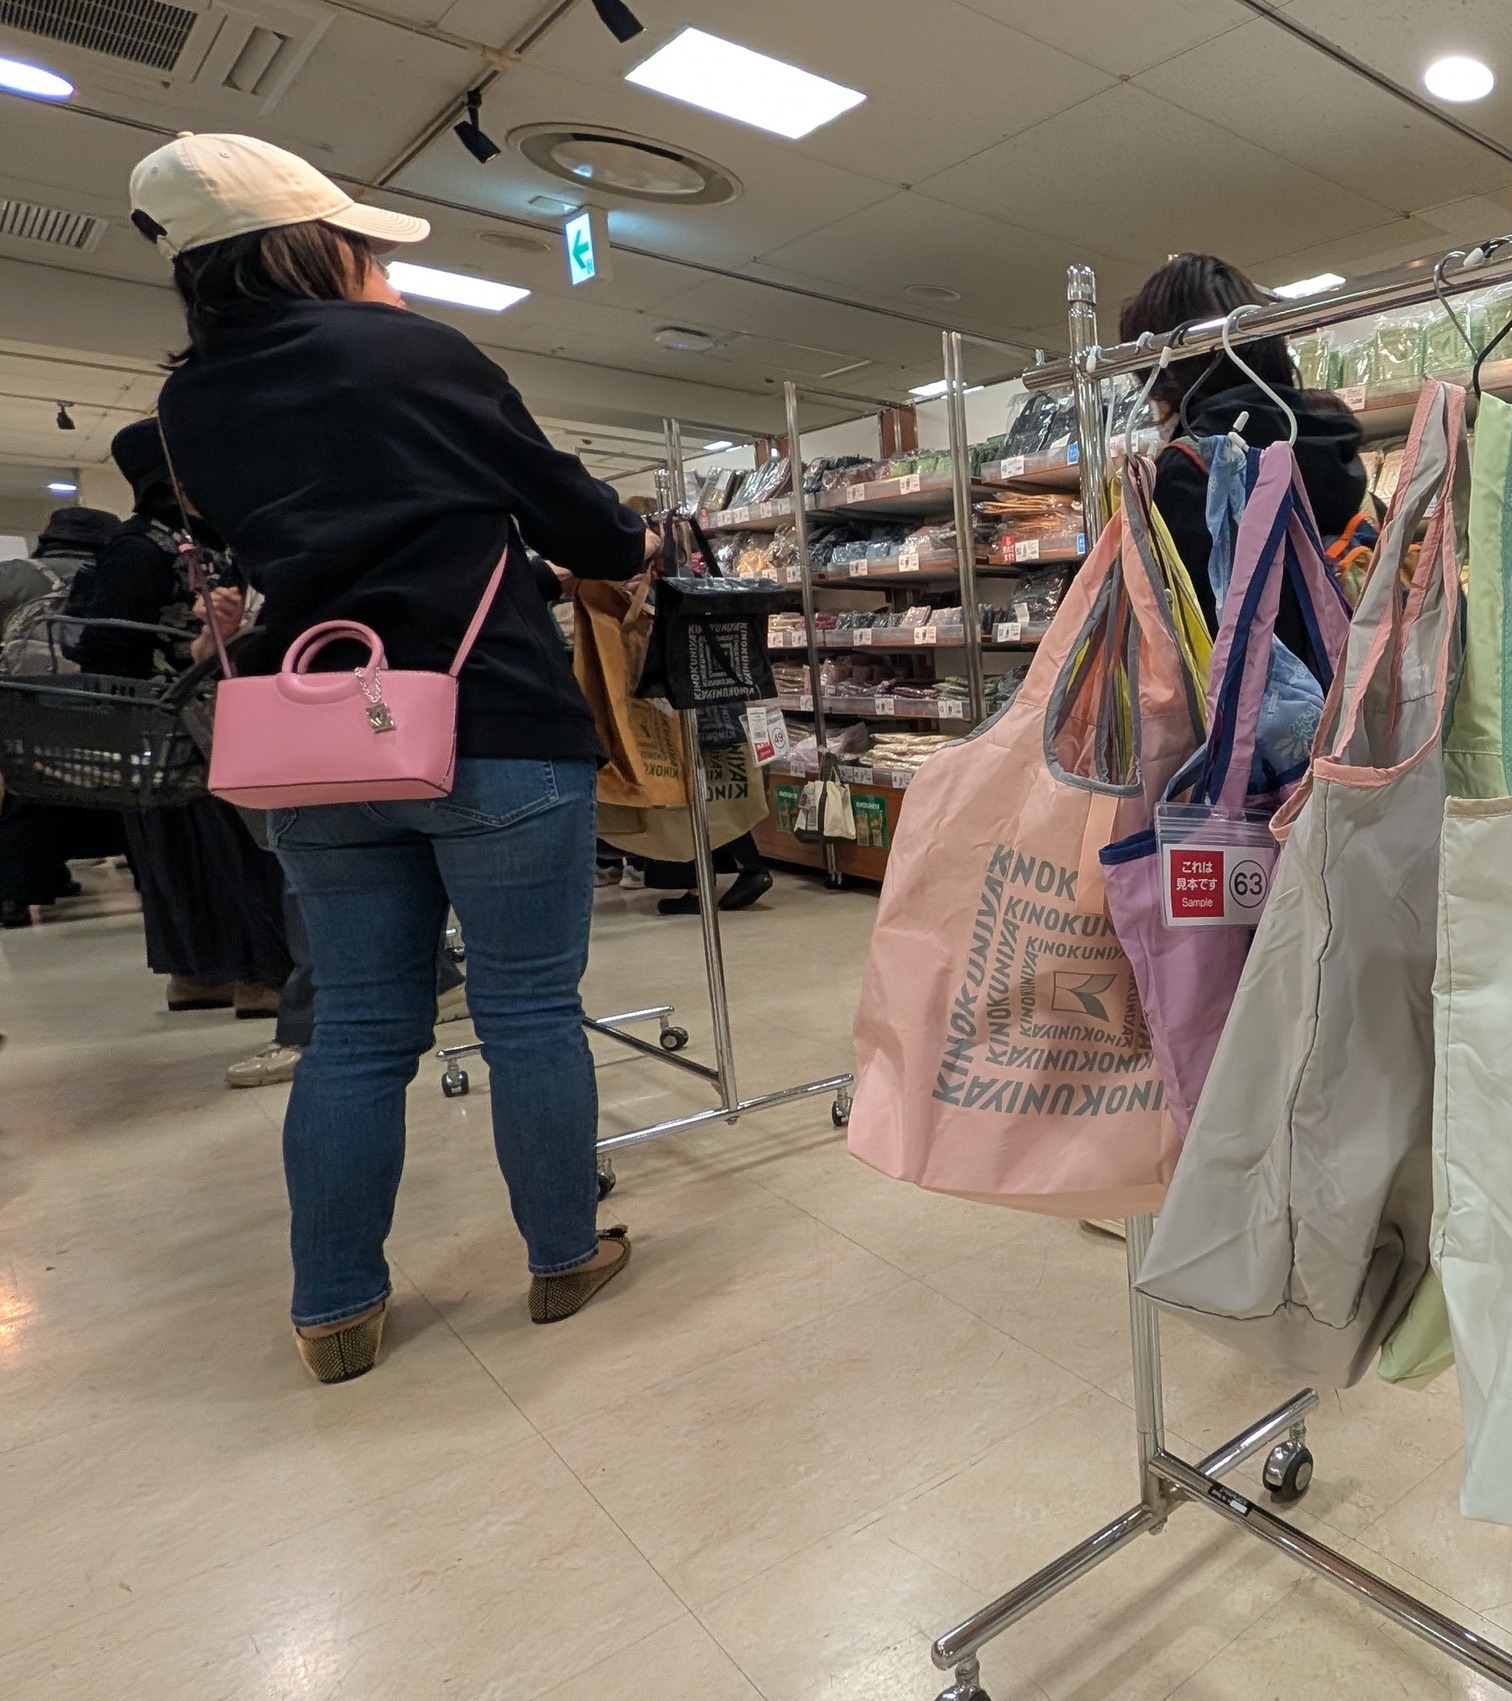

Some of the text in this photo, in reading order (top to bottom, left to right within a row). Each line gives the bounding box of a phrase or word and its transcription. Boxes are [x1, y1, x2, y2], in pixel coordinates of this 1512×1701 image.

[774, 732, 784, 744] 49
[1181, 861, 1213, 874] これは
[1175, 877, 1218, 891] 見本です
[1234, 872, 1263, 896] 63
[1181, 897, 1213, 908] Sample
[932, 875, 1005, 1106] KINOKUNIYA
[985, 917, 1021, 1065] KINOKUNIYA
[1019, 950, 1039, 1038] KINOKUNIYA
[1032, 1023, 1133, 1048] KINOKUNIYA
[1004, 1044, 1155, 1074] KINOKUNIYA
[960, 1075, 1169, 1117] INOKUNIYA
